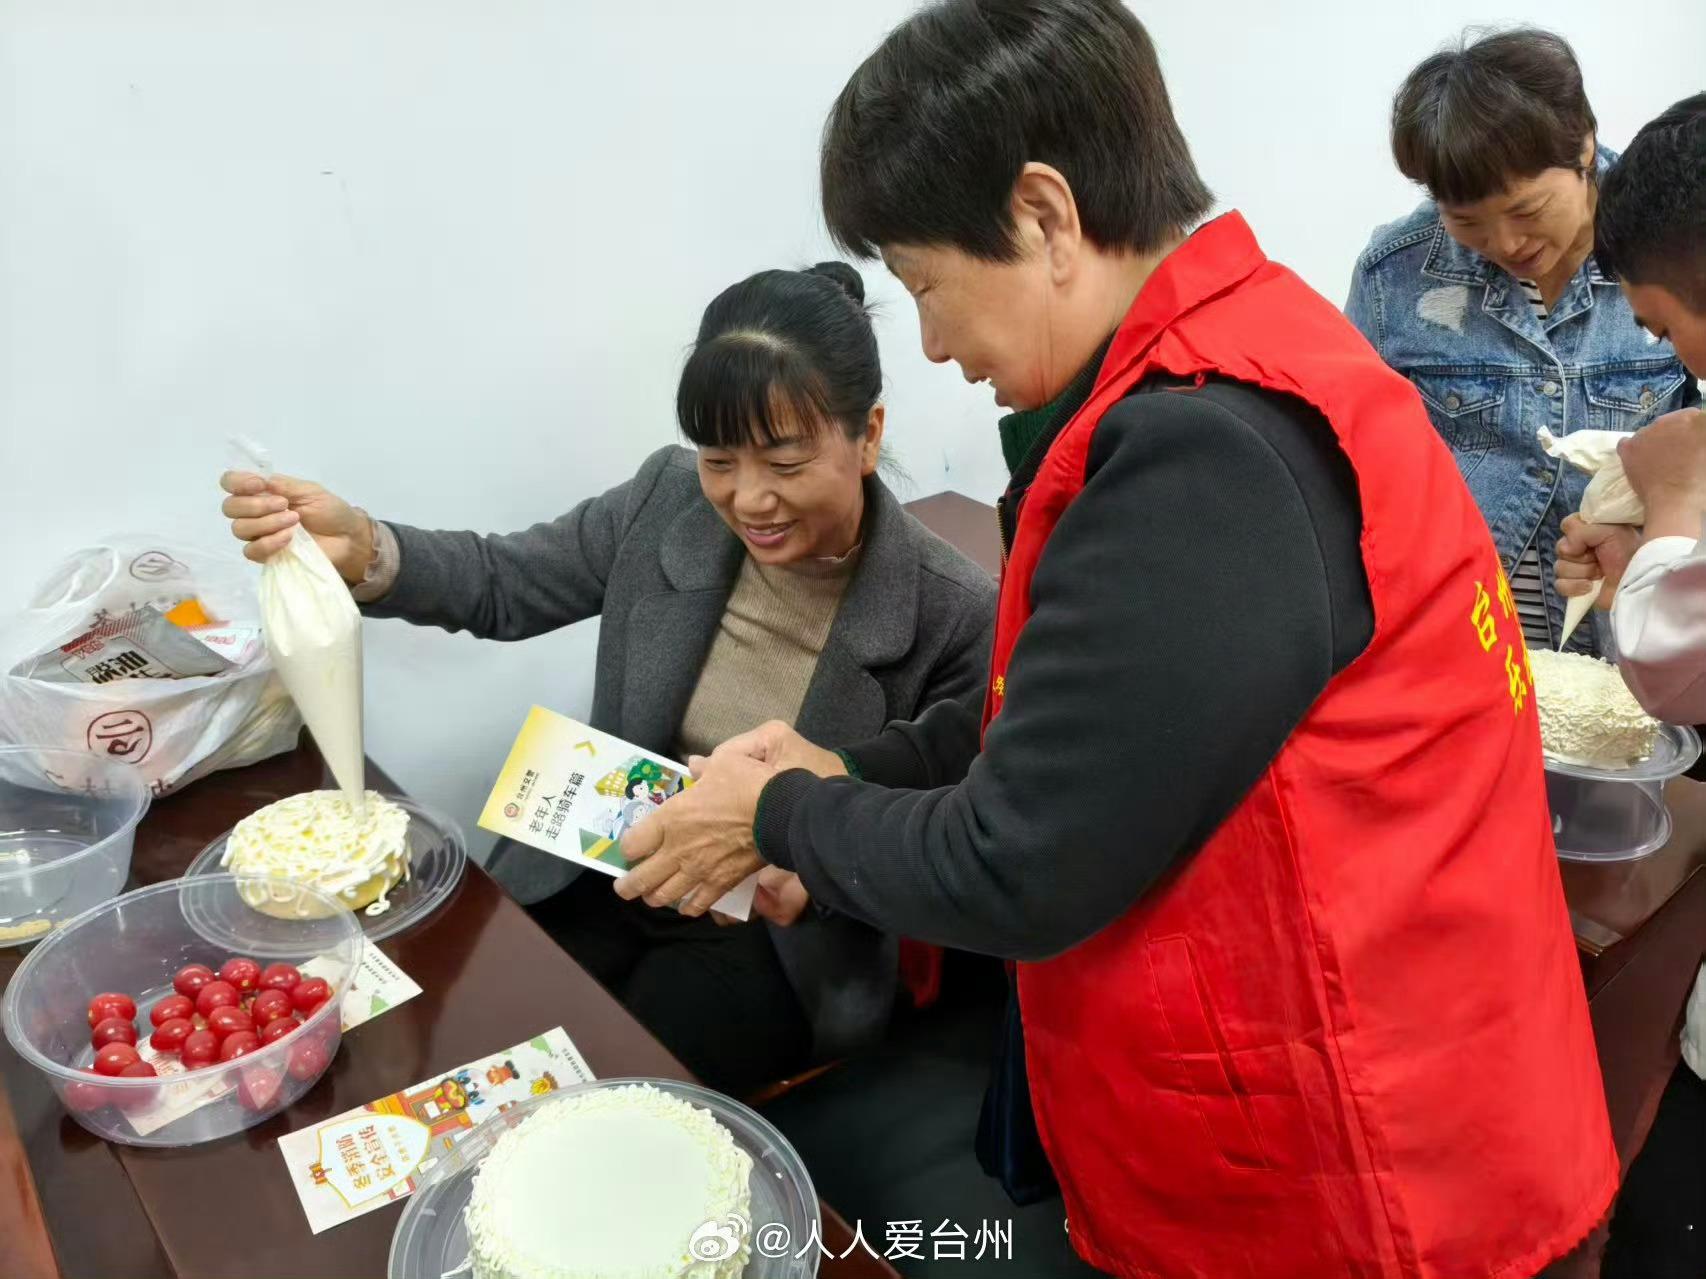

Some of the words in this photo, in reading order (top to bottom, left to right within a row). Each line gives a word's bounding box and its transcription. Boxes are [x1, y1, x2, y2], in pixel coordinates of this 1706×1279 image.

[529, 795, 557, 833] 老年人
[546, 771, 585, 840] 走路骑车篇
[358, 1125, 396, 1180] 安全宣传
